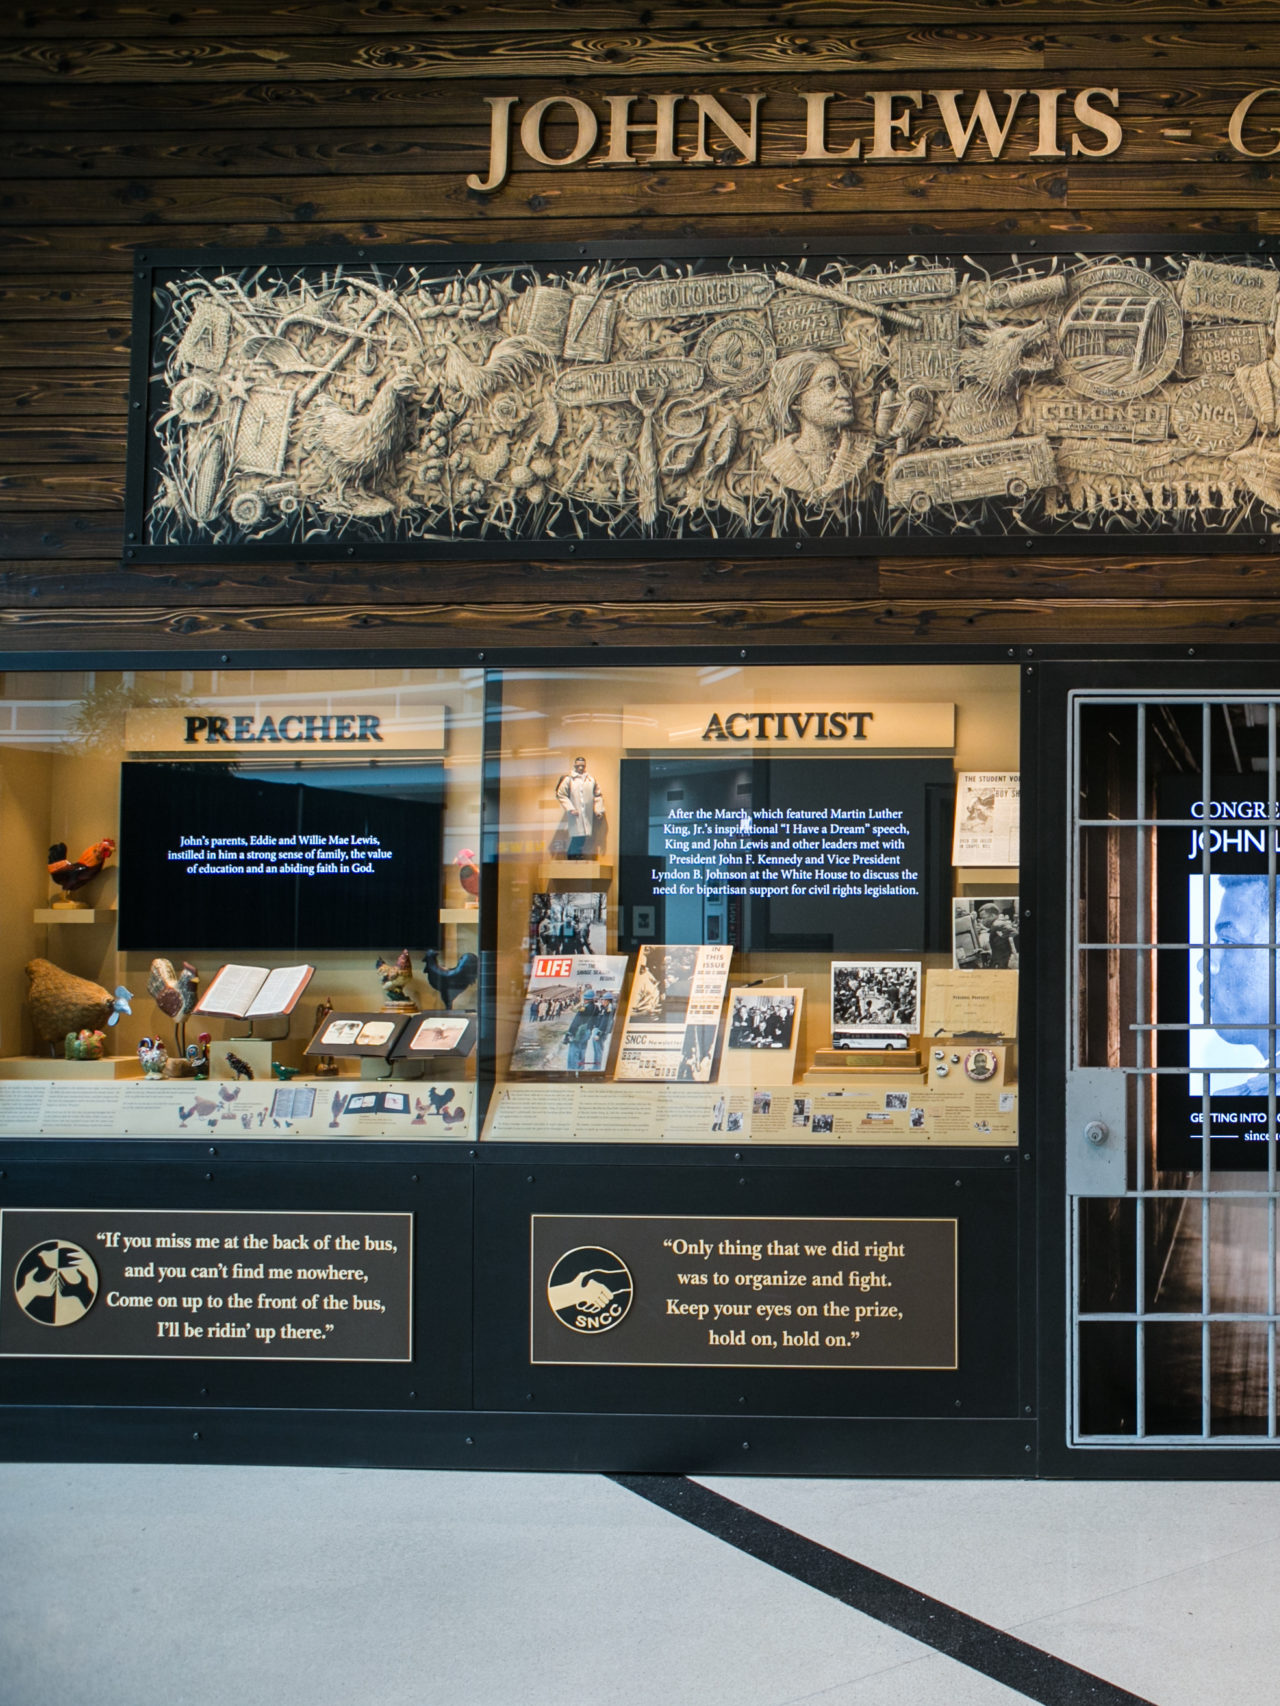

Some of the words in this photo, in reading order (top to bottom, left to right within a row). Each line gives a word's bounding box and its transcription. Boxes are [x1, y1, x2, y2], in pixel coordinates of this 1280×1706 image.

[465, 94, 767, 193] JOHN
[801, 87, 1123, 160] LEWIS
[857, 277, 942, 299] PARCHMAN
[776, 303, 825, 319] EQUAL
[776, 314, 829, 333] RIGHTS
[777, 334, 799, 347] FOR
[588, 366, 671, 394] WHITES
[184, 713, 384, 744] PREACHER
[702, 711, 874, 742] ACTIVIST
[964, 775, 976, 783] THE
[979, 775, 1007, 783] STUDENT
[210, 836, 248, 848] parents,
[249, 834, 277, 845] Eddie
[278, 834, 296, 845] and
[298, 834, 326, 845] Willie
[328, 835, 349, 845] Mae
[350, 834, 380, 847] Lewis,
[1188, 829, 1265, 860] JOHN
[652, 868, 690, 882] Lyndon
[692, 868, 703, 879] B.
[704, 868, 747, 882] Johnson
[749, 870, 759, 879] at
[762, 868, 778, 879] the
[780, 868, 812, 879] White
[814, 869, 848, 879] House
[849, 870, 860, 879] to
[862, 868, 899, 879] discuss
[901, 868, 918, 879] the
[652, 883, 677, 894] need
[678, 883, 695, 895] for
[696, 883, 747, 897] bipartisan
[748, 885, 788, 897] support
[791, 883, 806, 894] for
[808, 883, 830, 894] civil
[832, 884, 862, 897] rights
[864, 884, 918, 898] legislation.
[535, 959, 572, 976] LIFE
[625, 1034, 648, 1045] SNCC
[1190, 1112, 1238, 1123] GETING
[1240, 1112, 1267, 1123] INTO
[1244, 1130, 1270, 1141] since
[123, 1236, 151, 1252] you
[155, 1232, 191, 1248] miss
[195, 1237, 220, 1248] me
[224, 1236, 239, 1248] at
[242, 1233, 268, 1249] the
[272, 1234, 309, 1249] back
[313, 1234, 332, 1250] of
[334, 1234, 360, 1250] the
[364, 1235, 397, 1253] bus,
[718, 1239, 762, 1260] thing
[766, 1240, 800, 1256] that
[804, 1245, 826, 1256] we
[831, 1240, 860, 1256] did
[864, 1241, 905, 1262] right
[575, 1302, 623, 1329] SNCC
[708, 1329, 746, 1345] hold
[750, 1334, 777, 1348] on,
[782, 1330, 820, 1346] hold
